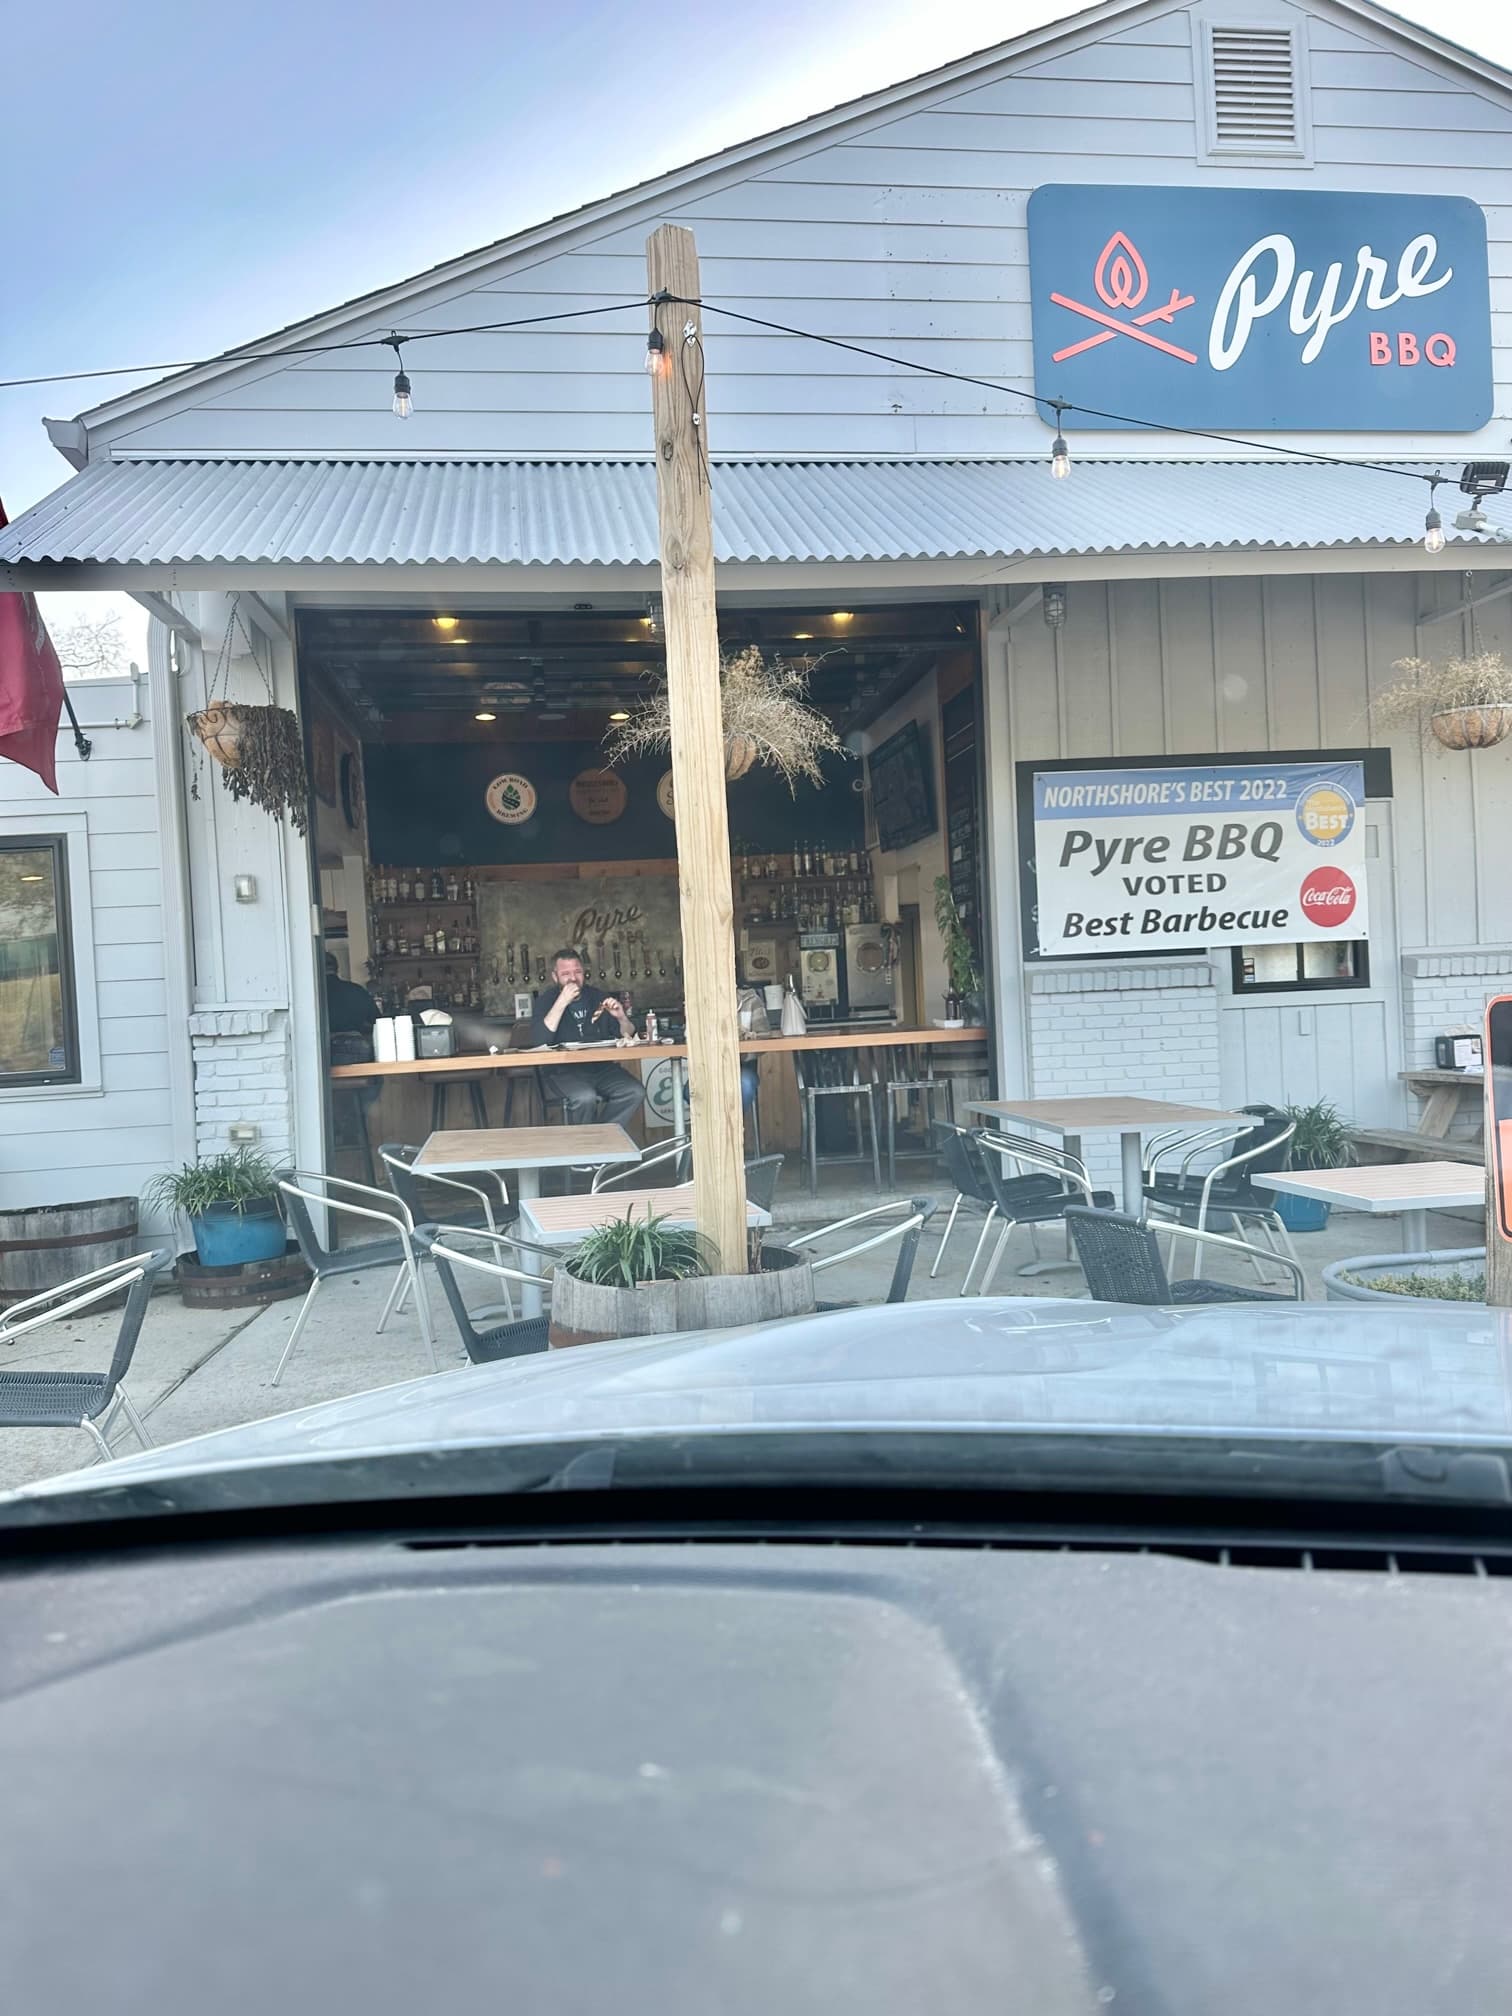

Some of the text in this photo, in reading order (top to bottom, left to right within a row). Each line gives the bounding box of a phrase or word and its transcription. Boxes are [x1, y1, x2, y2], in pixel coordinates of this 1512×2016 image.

[1208, 232, 1453, 371] Pyre
[1369, 331, 1457, 368] BBQ
[493, 778, 507, 790] LOW
[1043, 782, 1187, 809] NORTHSHORE'S
[1190, 781, 1235, 802] BEST
[1240, 779, 1288, 801] 2022
[1304, 811, 1349, 830] BEST
[1059, 821, 1284, 877] Pyre BBQ
[1122, 872, 1228, 897] VOTED
[573, 904, 643, 946] Pyre
[1062, 906, 1289, 938] Best Barbecue
